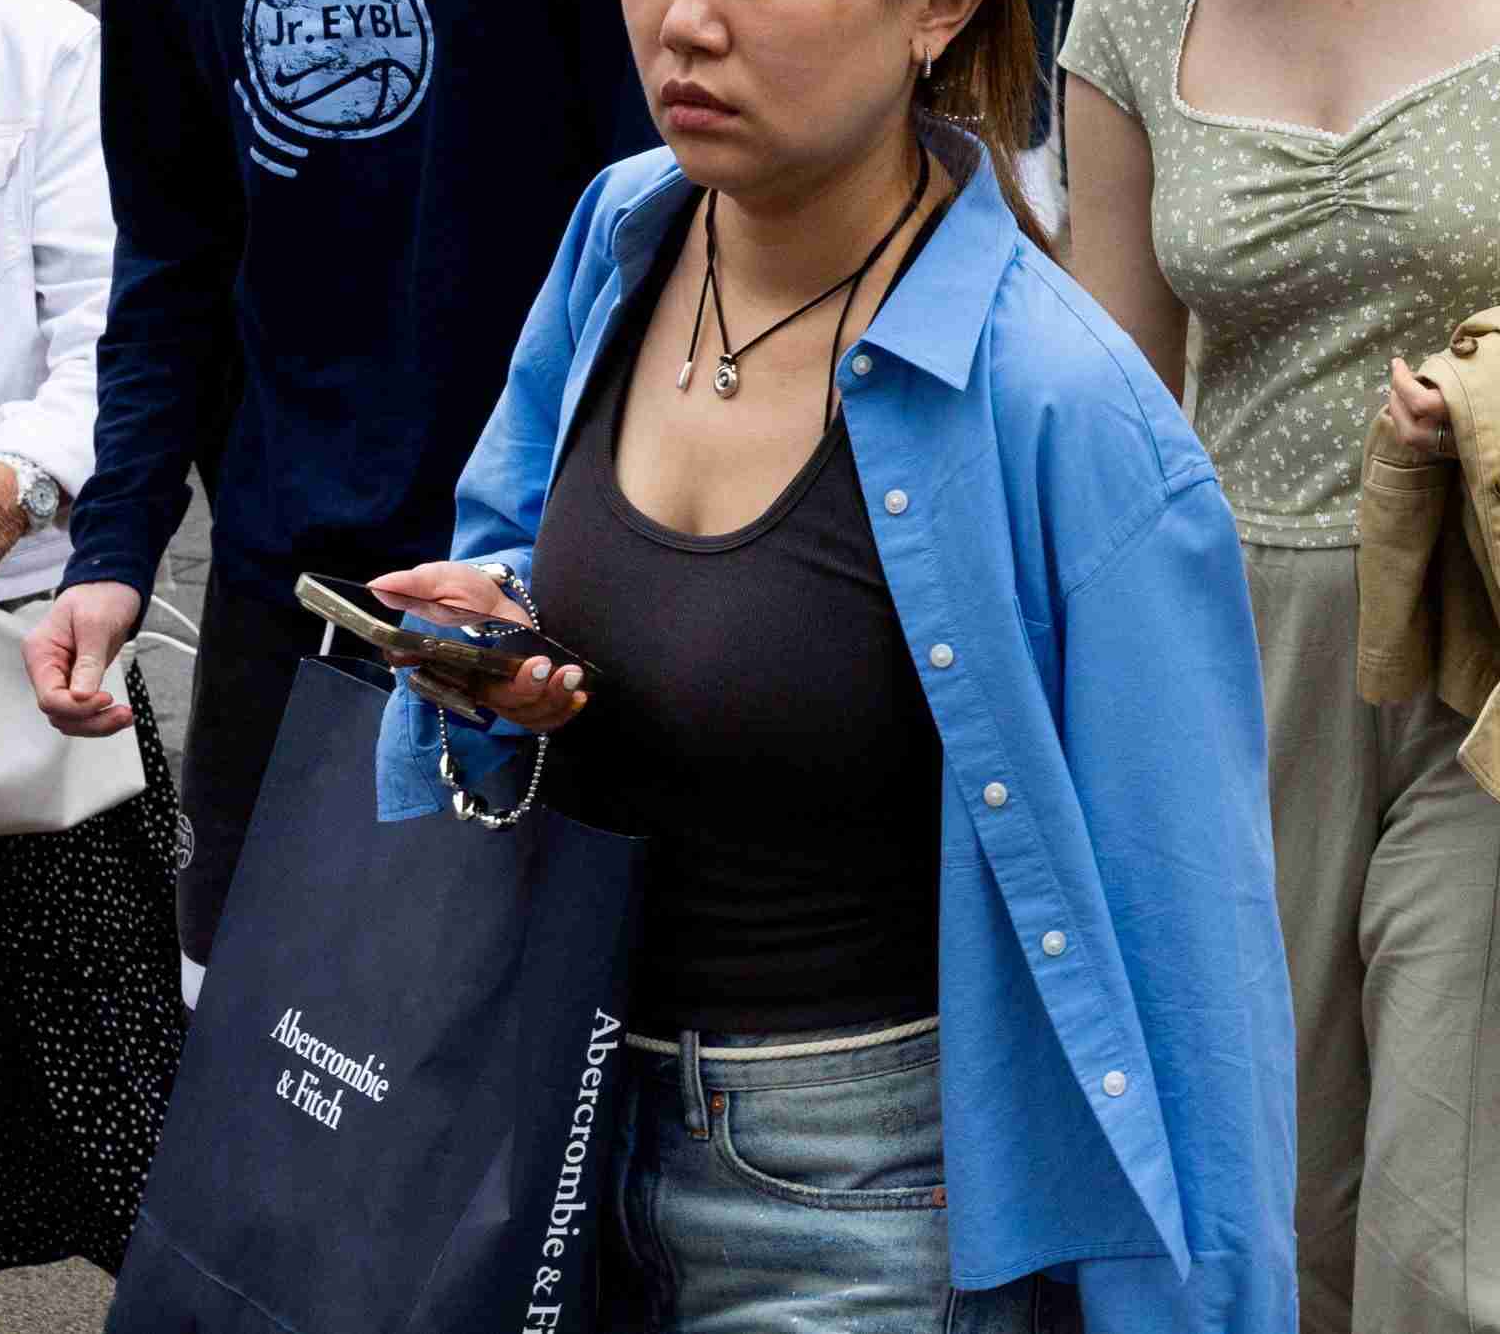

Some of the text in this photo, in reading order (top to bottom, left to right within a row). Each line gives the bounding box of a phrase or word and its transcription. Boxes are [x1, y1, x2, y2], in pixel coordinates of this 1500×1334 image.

[268, 3, 412, 47] Jr. EYBL
[269, 1007, 389, 1103] Abercrombie
[276, 1069, 343, 1131] & Fitch
[541, 1008, 622, 1259] Abercrombie
[533, 1266, 562, 1296] &
